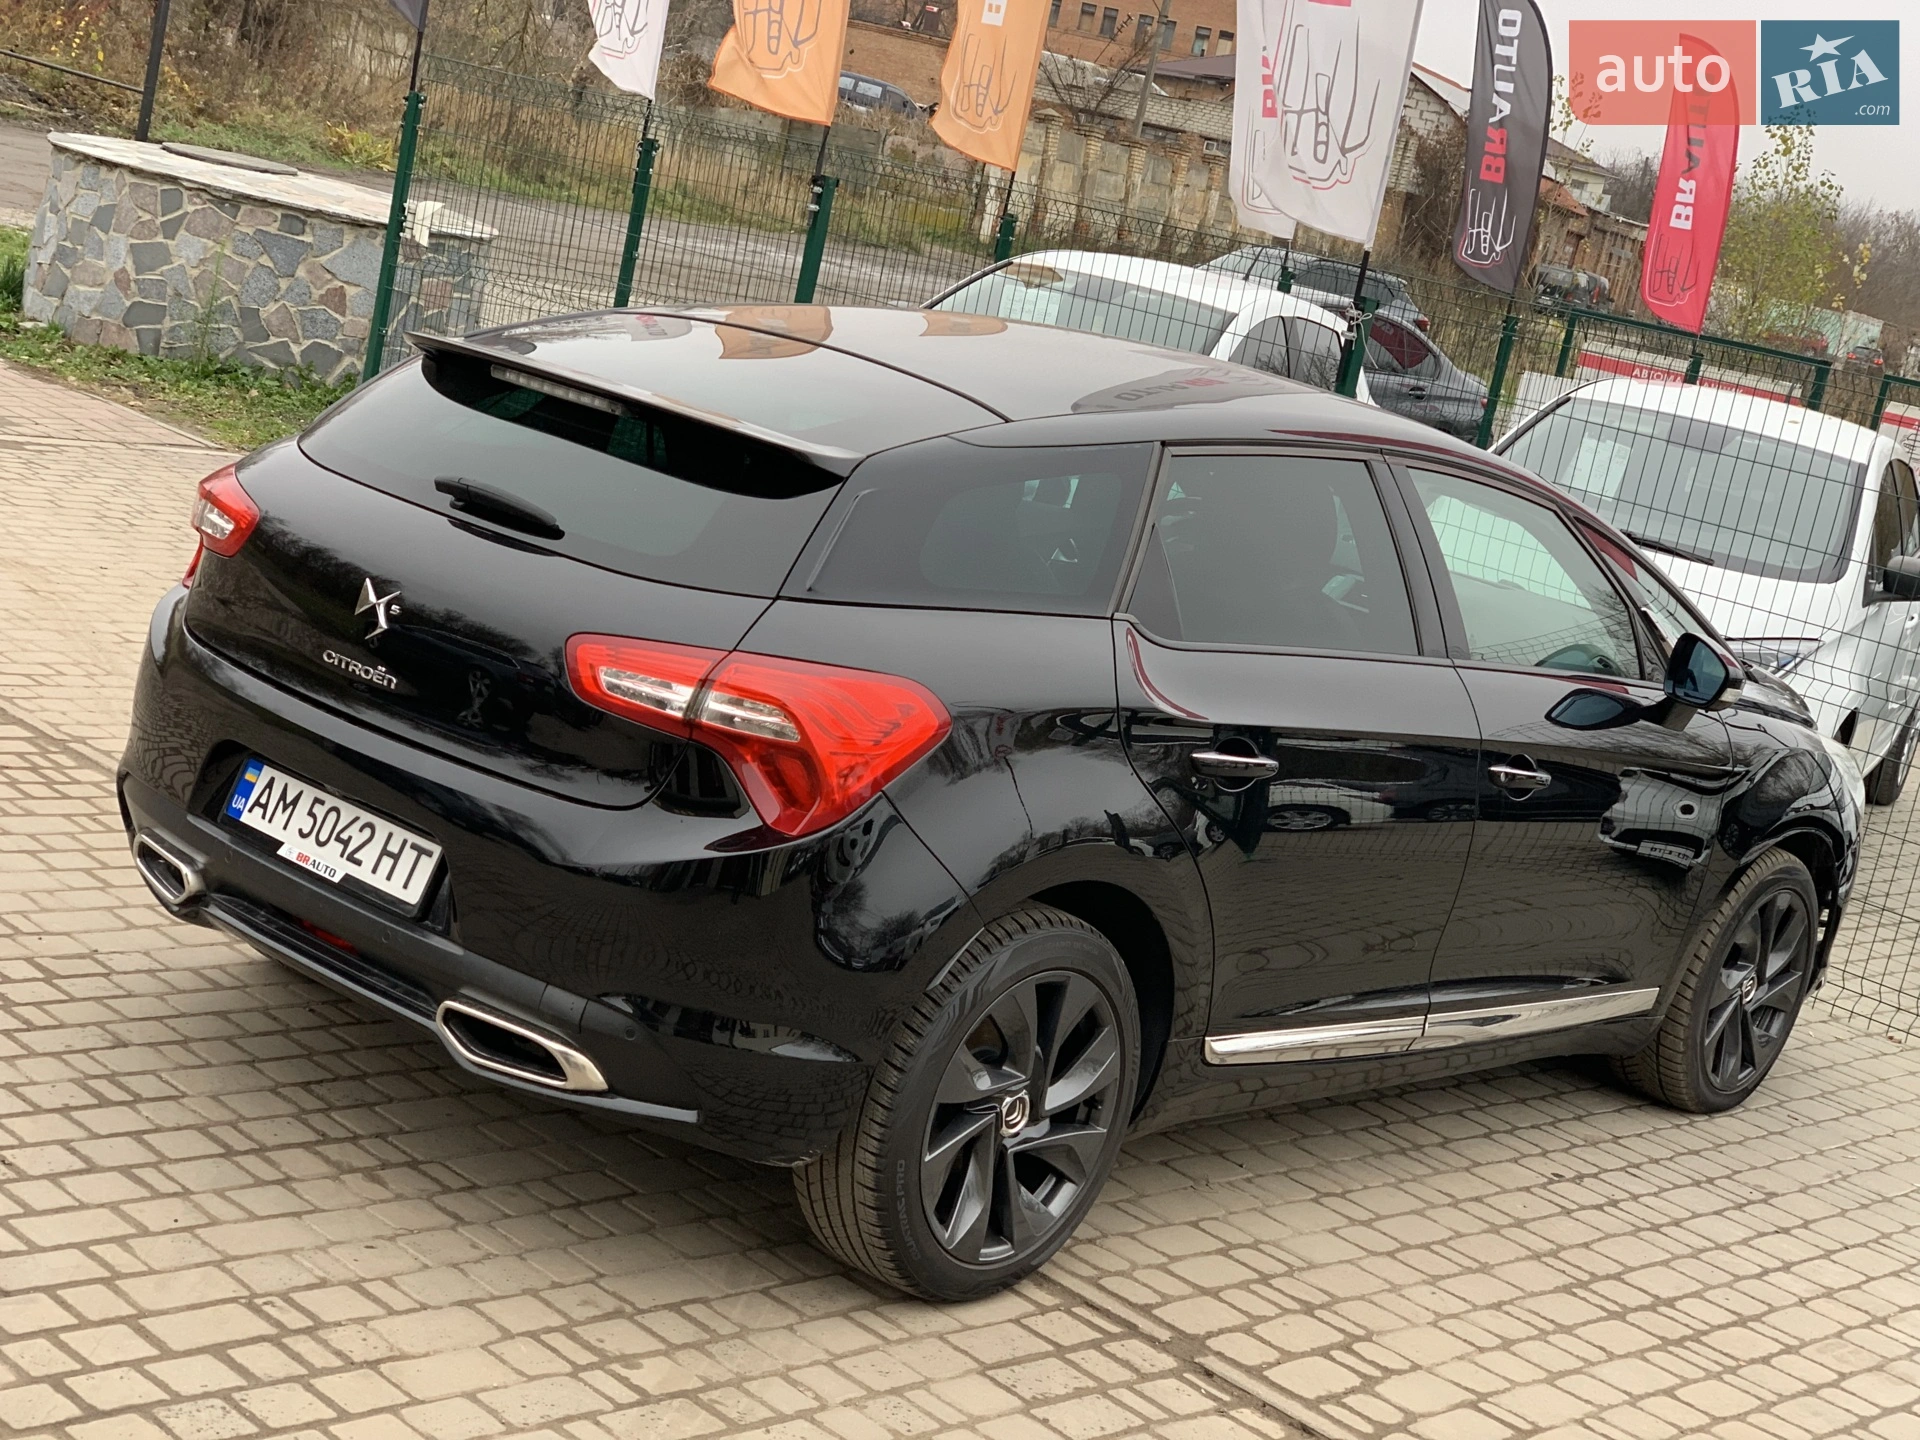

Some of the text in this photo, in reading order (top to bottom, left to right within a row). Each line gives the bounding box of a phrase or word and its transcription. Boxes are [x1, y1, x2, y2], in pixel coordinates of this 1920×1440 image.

[231, 794, 245, 812] UA
[247, 776, 434, 890] AM 5042 HT
[296, 851, 337, 878] BRAUTO
